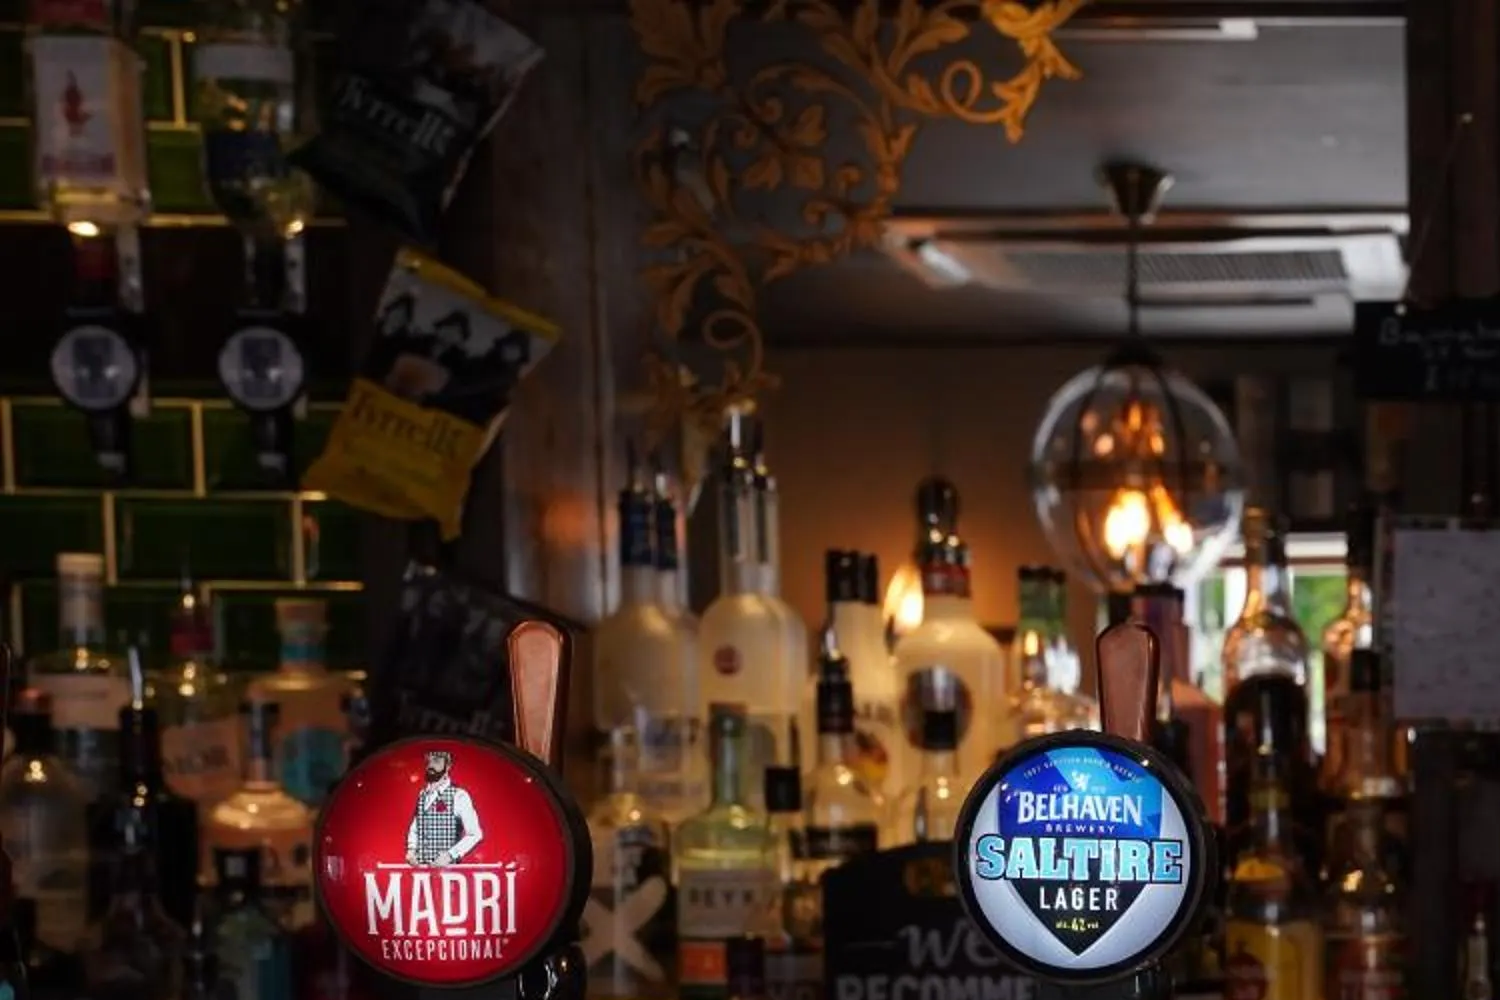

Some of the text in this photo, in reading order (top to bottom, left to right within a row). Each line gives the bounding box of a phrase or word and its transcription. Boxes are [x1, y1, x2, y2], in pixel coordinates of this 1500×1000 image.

[1017, 790, 1143, 828] BELHAVEN
[1045, 823, 1115, 835] BREWERY
[976, 833, 1183, 884] SALTIRE
[1039, 886, 1119, 912] LAGER
[380, 938, 503, 961] EXCEPCIONAL
